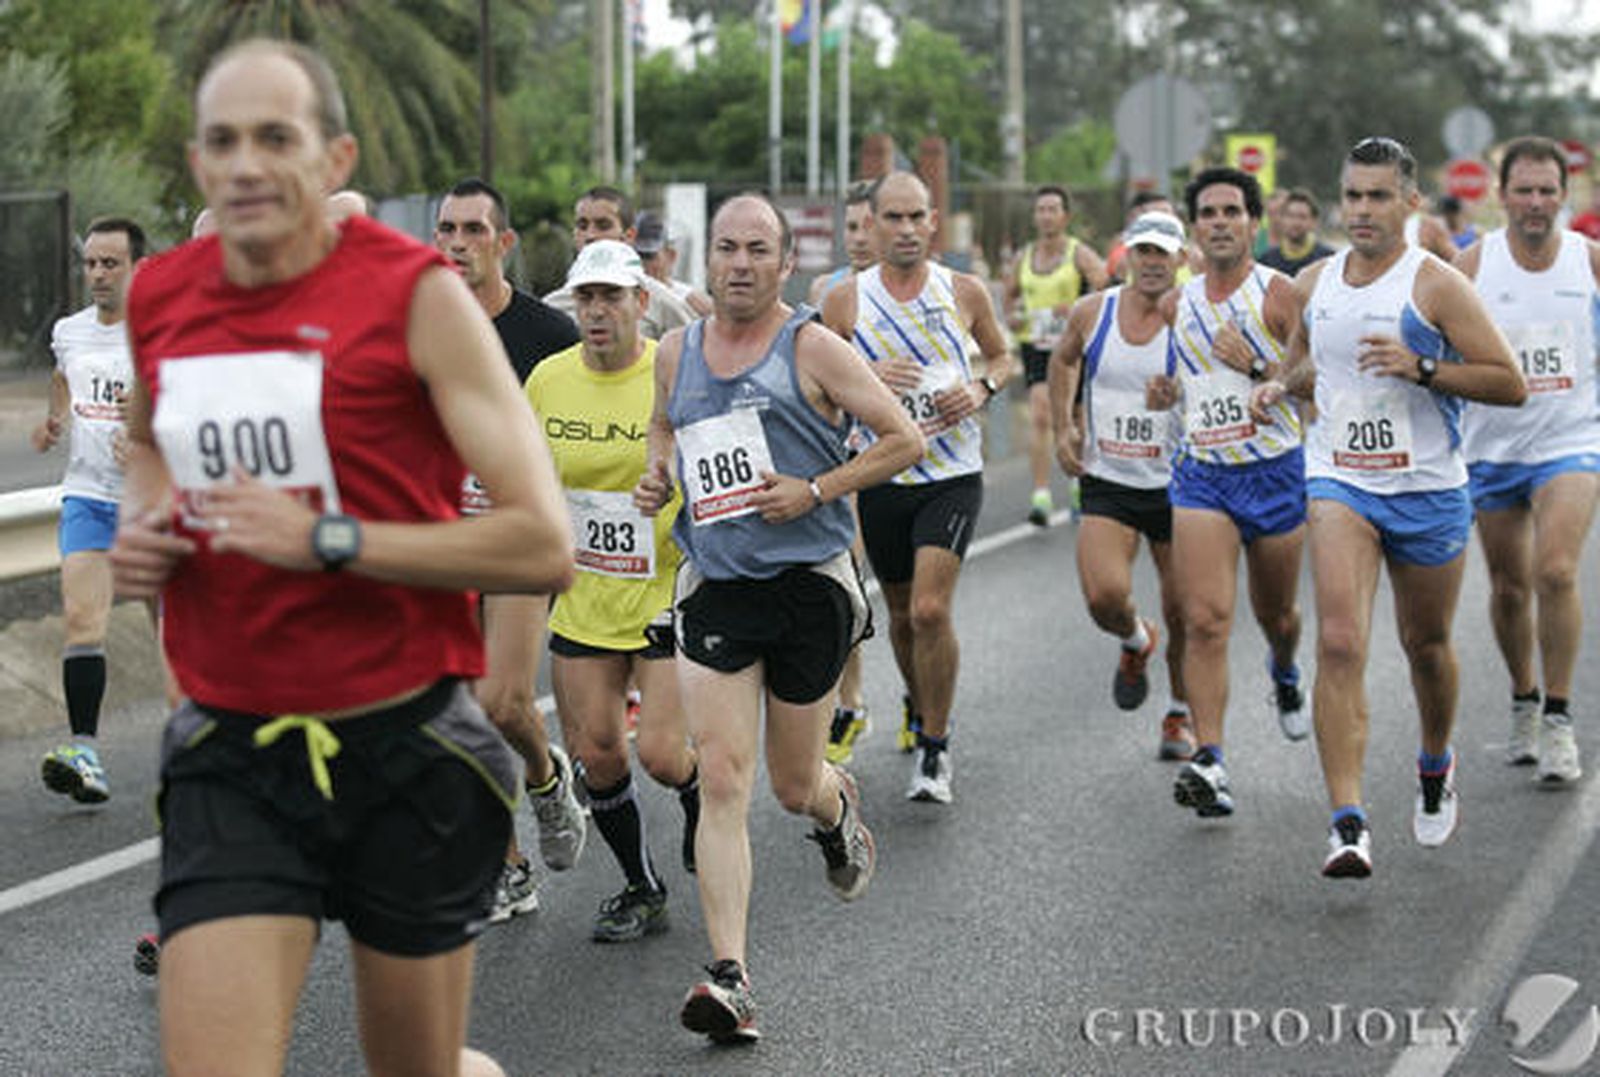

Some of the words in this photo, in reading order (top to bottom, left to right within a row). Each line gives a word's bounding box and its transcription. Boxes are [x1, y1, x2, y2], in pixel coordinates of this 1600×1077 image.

[1520, 348, 1562, 374] 195
[1200, 395, 1243, 427] 335
[545, 417, 648, 442] OSUN
[1347, 419, 1394, 452] 206
[198, 417, 294, 479] 900
[699, 447, 753, 494] 986
[588, 520, 635, 553] 283
